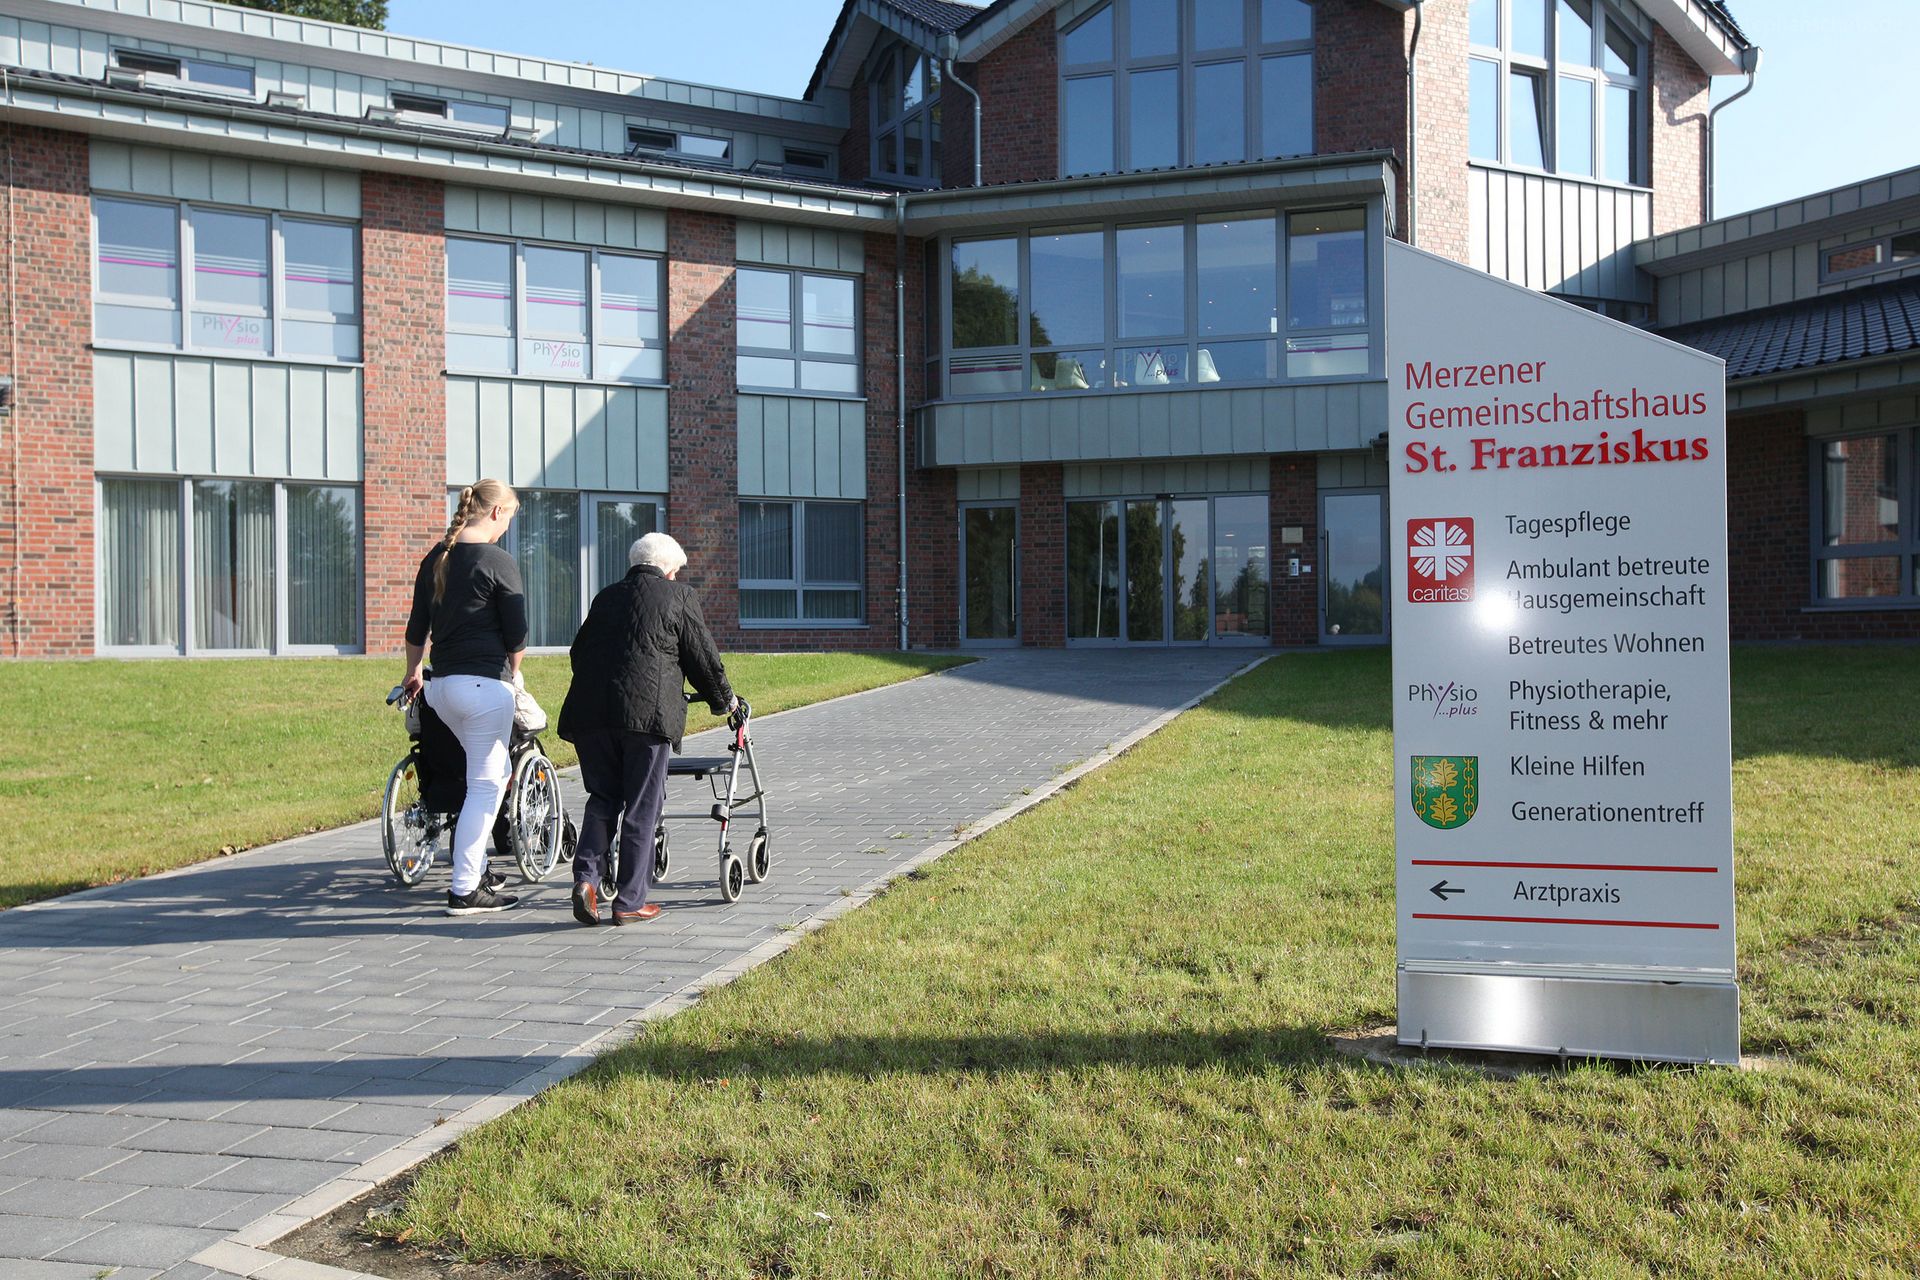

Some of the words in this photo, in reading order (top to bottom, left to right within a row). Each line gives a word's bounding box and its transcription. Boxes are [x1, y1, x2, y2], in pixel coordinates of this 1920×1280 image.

[533, 341, 580, 367] Physio
[1405, 360, 1547, 391] Merzener
[1405, 387, 1708, 431] Gemeinschaftshaus
[1405, 441, 1457, 474] St.
[1470, 428, 1710, 471] Franziskus
[1505, 510, 1632, 540] Tagespflege
[1506, 556, 1611, 581] Ambulant
[1617, 555, 1710, 578] betreute
[1412, 584, 1470, 602] caritas
[1508, 635, 1608, 656] Betreutes
[1613, 631, 1706, 654] Wohnen
[1408, 681, 1478, 719] Physio
[1509, 678, 1672, 706] Physiotherapie,
[1510, 709, 1581, 731] Fitness
[1588, 709, 1605, 731] &
[1612, 708, 1669, 731] mehr
[1510, 754, 1576, 776] Kleine
[1583, 754, 1646, 777] Hilfen
[1511, 800, 1706, 825] Generationentreff
[1512, 880, 1621, 908] Arztpraxis
